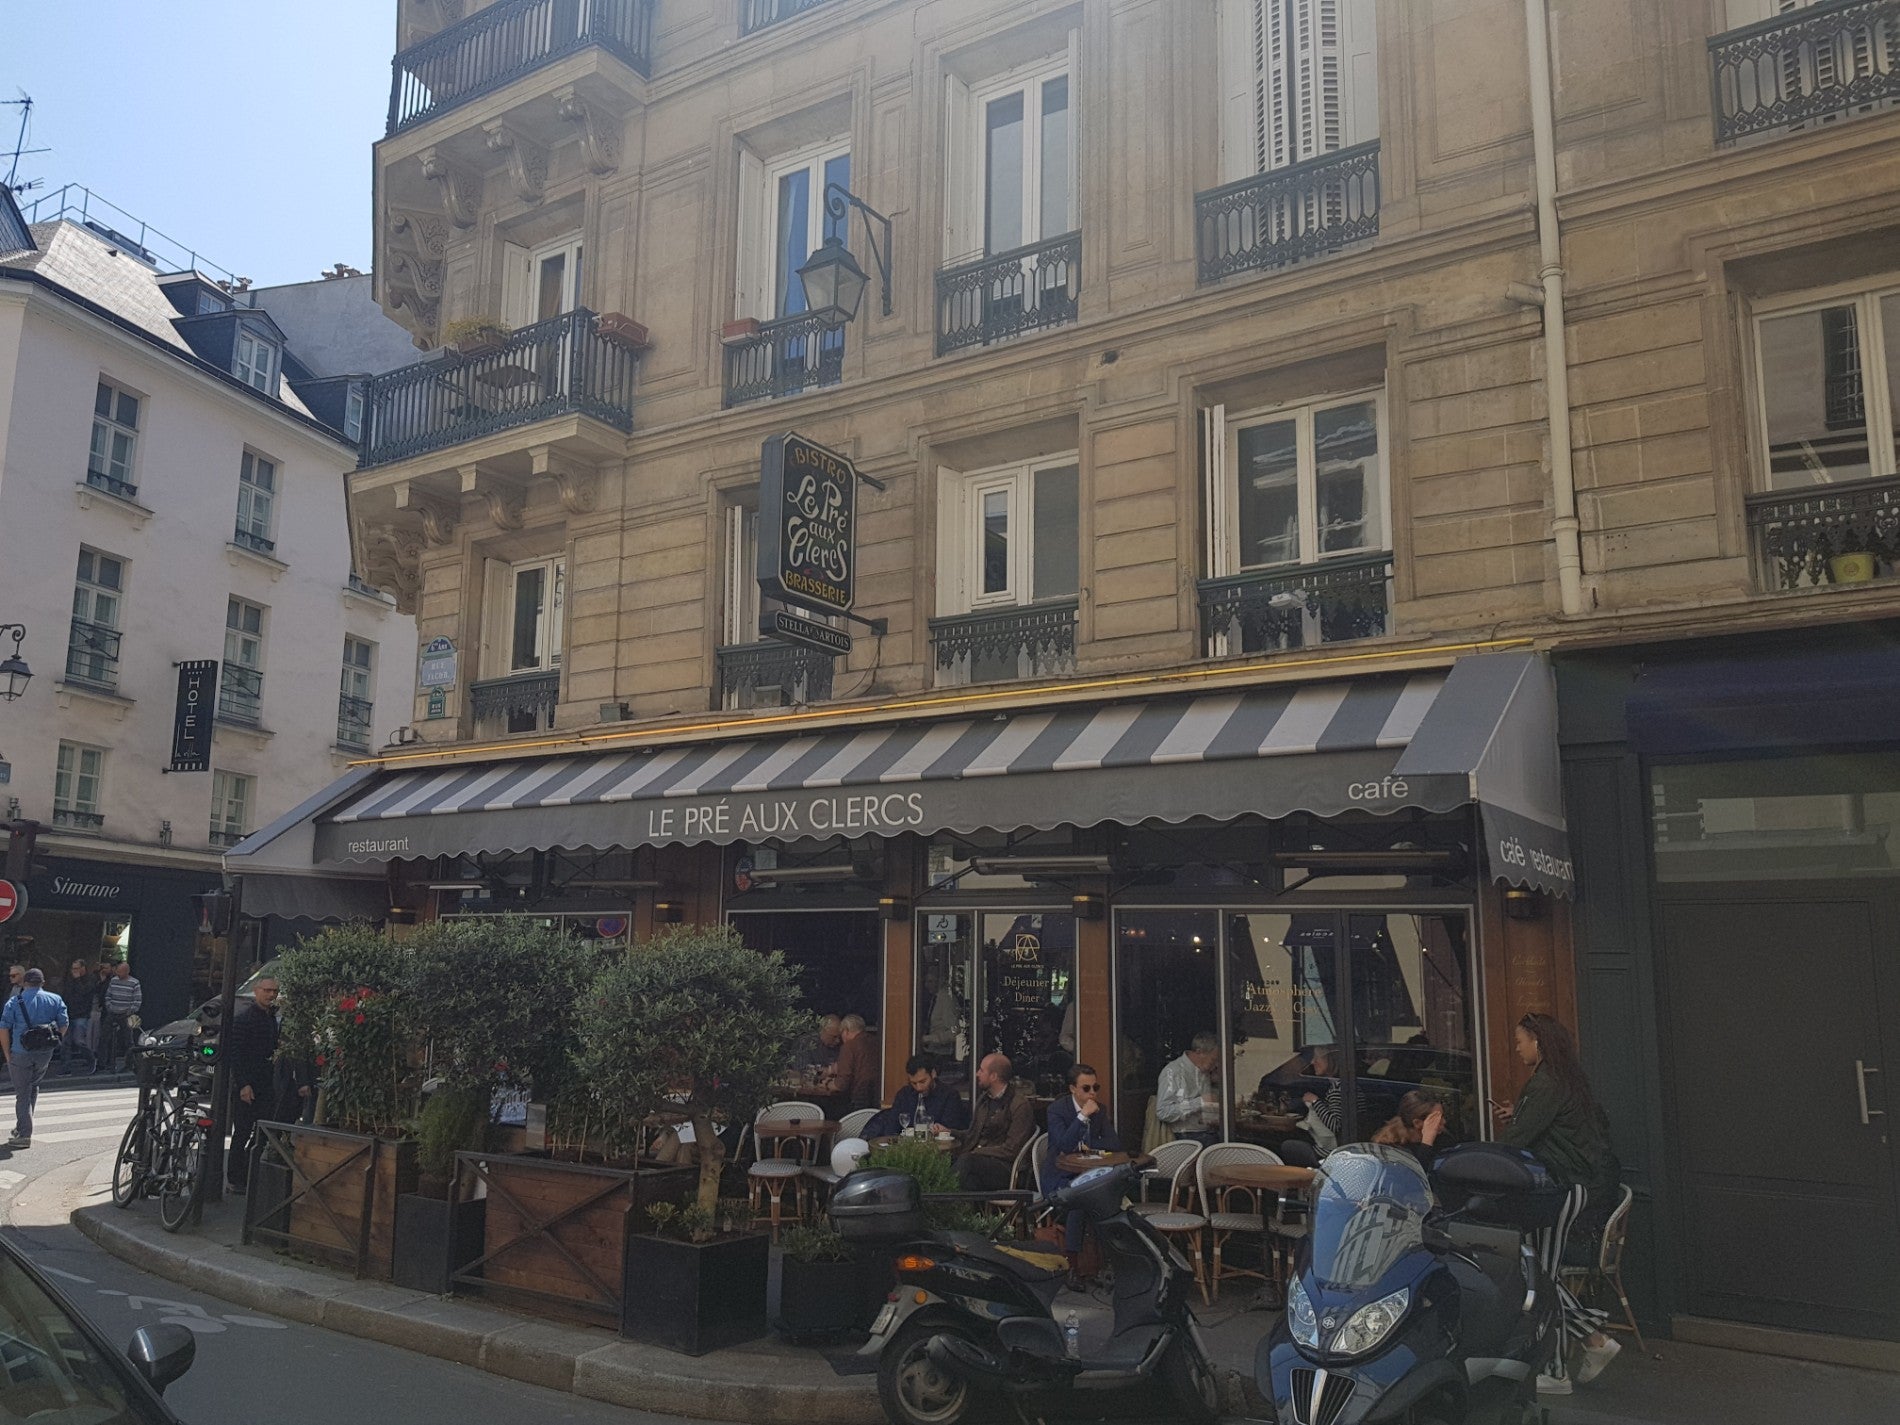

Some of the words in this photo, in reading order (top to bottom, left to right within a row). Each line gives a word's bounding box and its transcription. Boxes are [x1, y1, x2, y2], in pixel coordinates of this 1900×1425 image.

[794, 447, 847, 485] BISTRO
[787, 475, 820, 519] Le
[822, 480, 848, 534] Pré
[809, 520, 836, 545] aux
[785, 568, 847, 605] BRASSERIE
[778, 616, 811, 635] STELLA
[819, 629, 850, 649] ARTOIS
[183, 677, 200, 740] HOTEL
[1348, 776, 1409, 800] café
[649, 809, 675, 837] LE
[685, 798, 730, 835] PRÉ
[739, 801, 799, 833] AUX
[808, 792, 924, 830] CLERCS
[348, 835, 410, 853] restaurant
[1500, 835, 1526, 867] café
[50, 875, 120, 899] Simrane
[1004, 976, 1050, 990] Déjeuner
